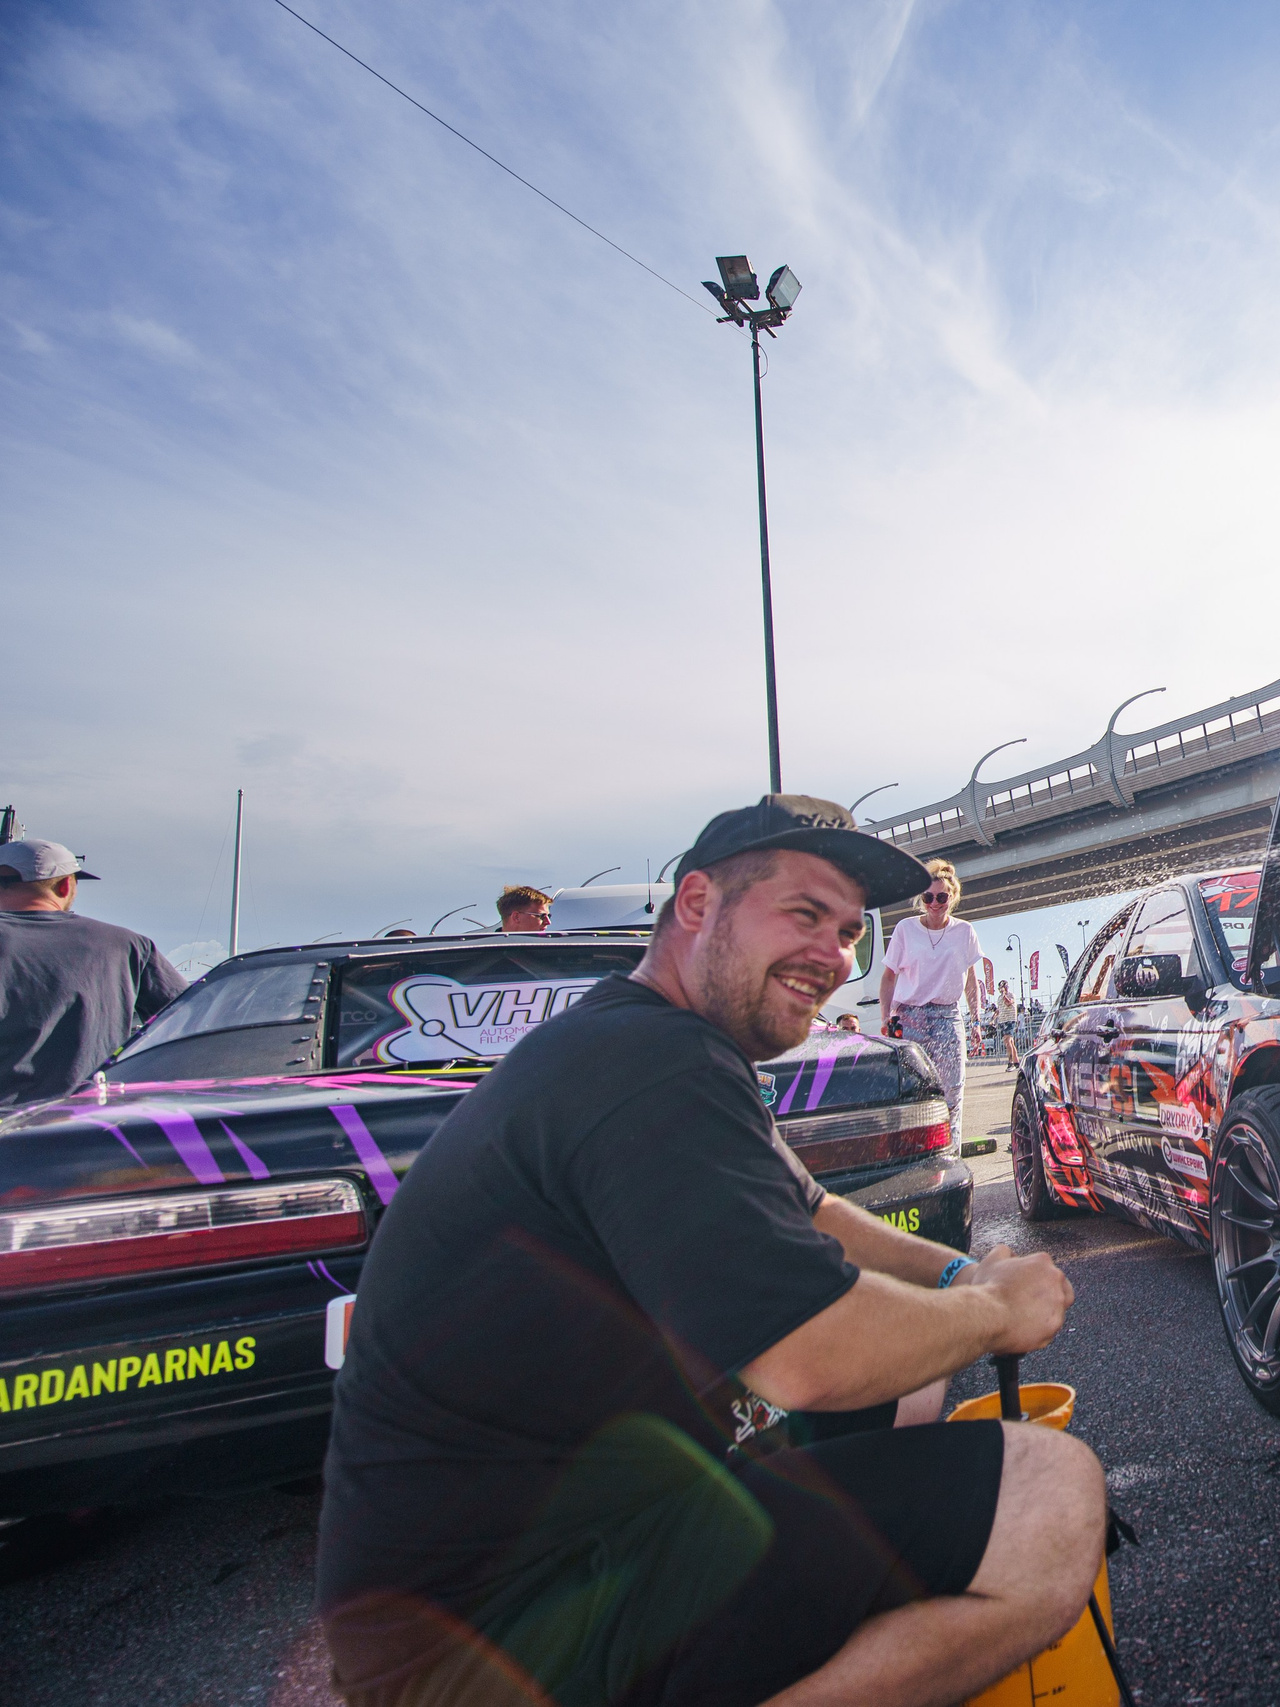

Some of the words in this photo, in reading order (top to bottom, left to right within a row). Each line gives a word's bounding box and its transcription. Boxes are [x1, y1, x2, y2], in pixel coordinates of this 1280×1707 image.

[479, 1025, 536, 1037] AUTOMO
[479, 1034, 516, 1044] FILMS
[1160, 1109, 1192, 1132] DRYDRY
[878, 1207, 920, 1233] NAS
